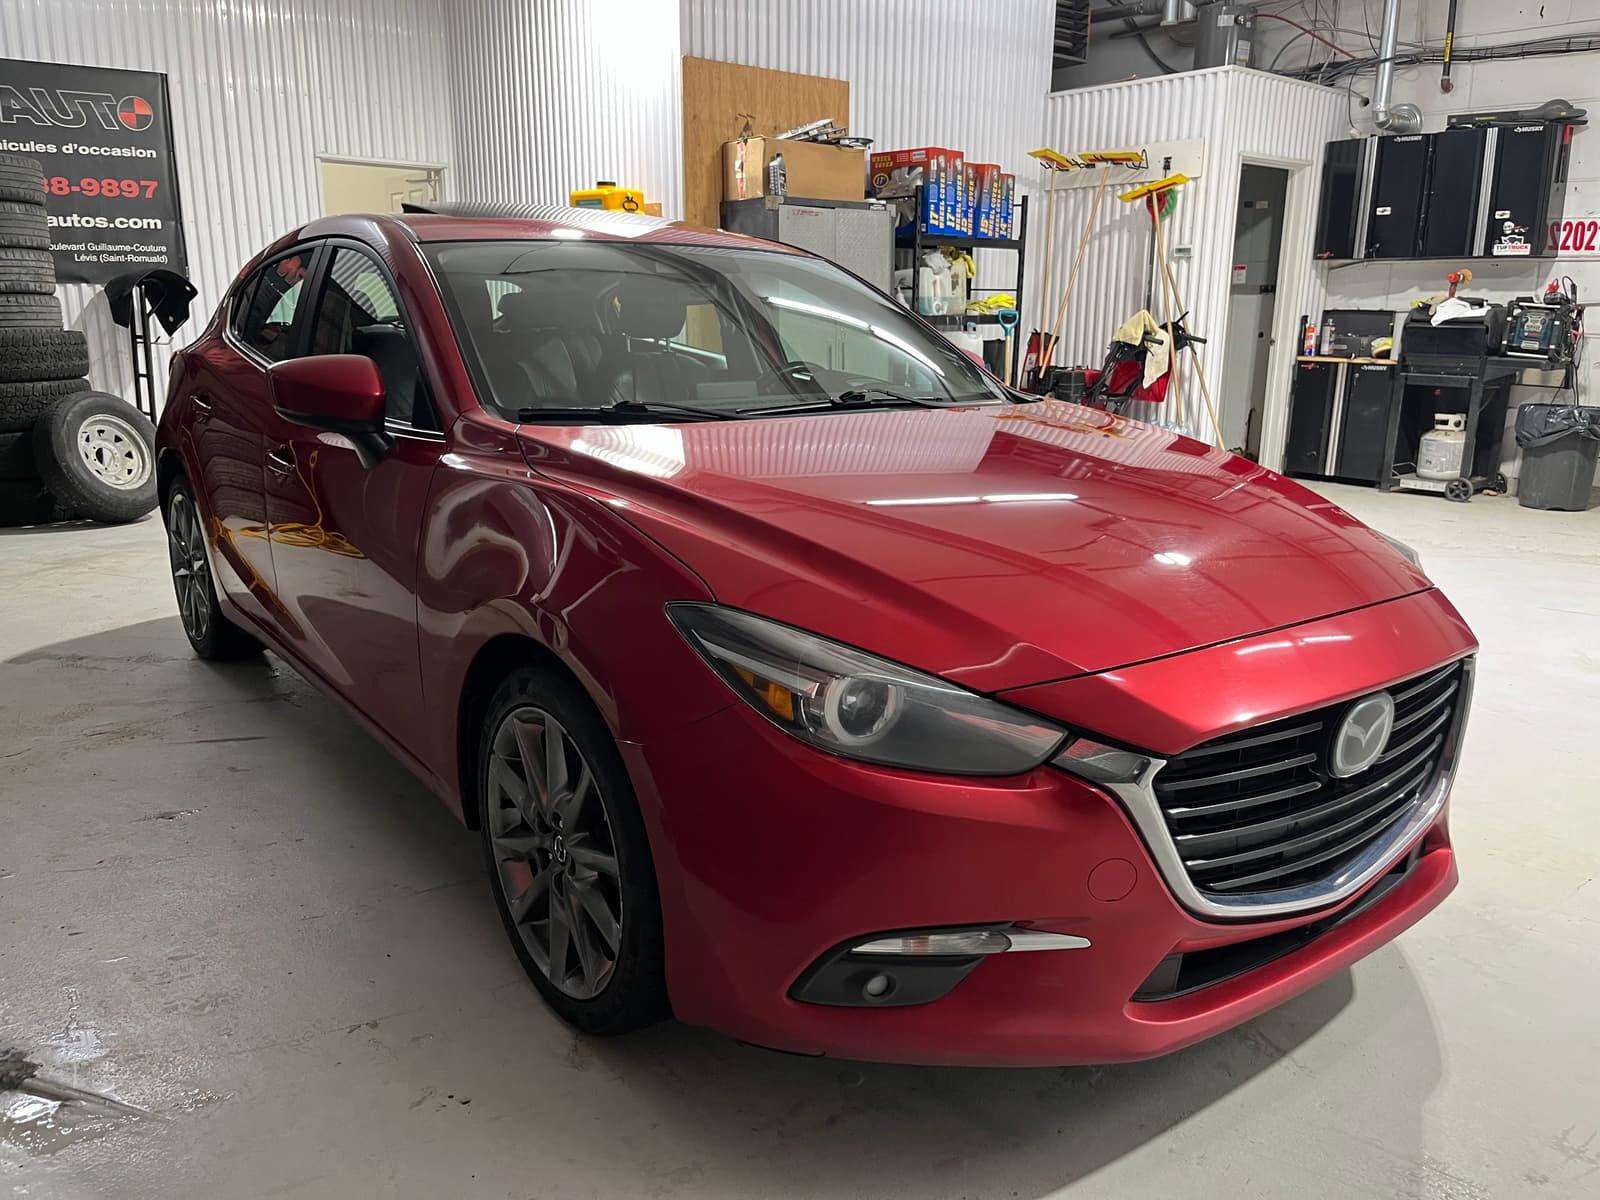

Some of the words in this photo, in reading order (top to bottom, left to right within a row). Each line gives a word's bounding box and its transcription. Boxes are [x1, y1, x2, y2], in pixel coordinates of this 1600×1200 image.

[1559, 220, 1600, 252] 202
[87, 243, 167, 253] Guillaume-Couture
[74, 253, 98, 262] Lévis
[99, 254, 168, 265] (Saint-Romuald)
